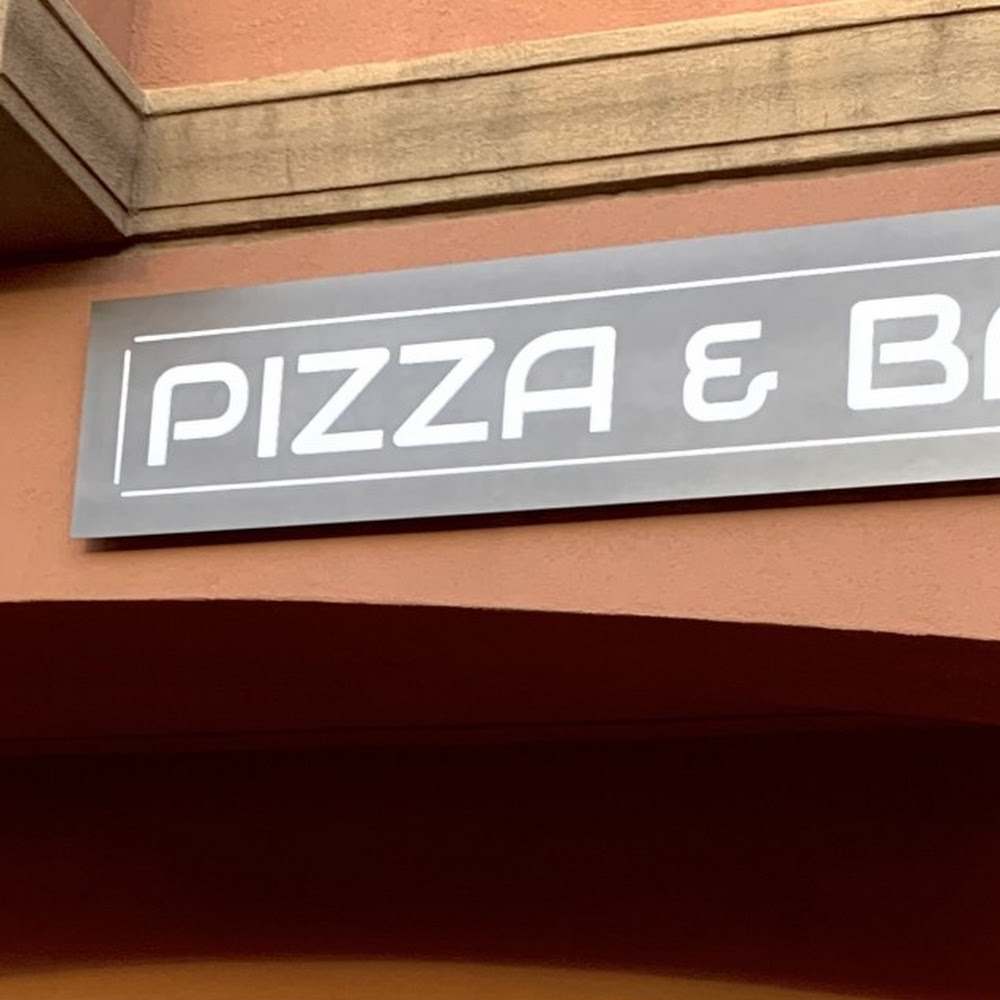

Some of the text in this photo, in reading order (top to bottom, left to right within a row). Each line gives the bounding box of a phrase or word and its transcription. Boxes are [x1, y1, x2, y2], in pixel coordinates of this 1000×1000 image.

[147, 292, 1000, 467] PIZZA & B
